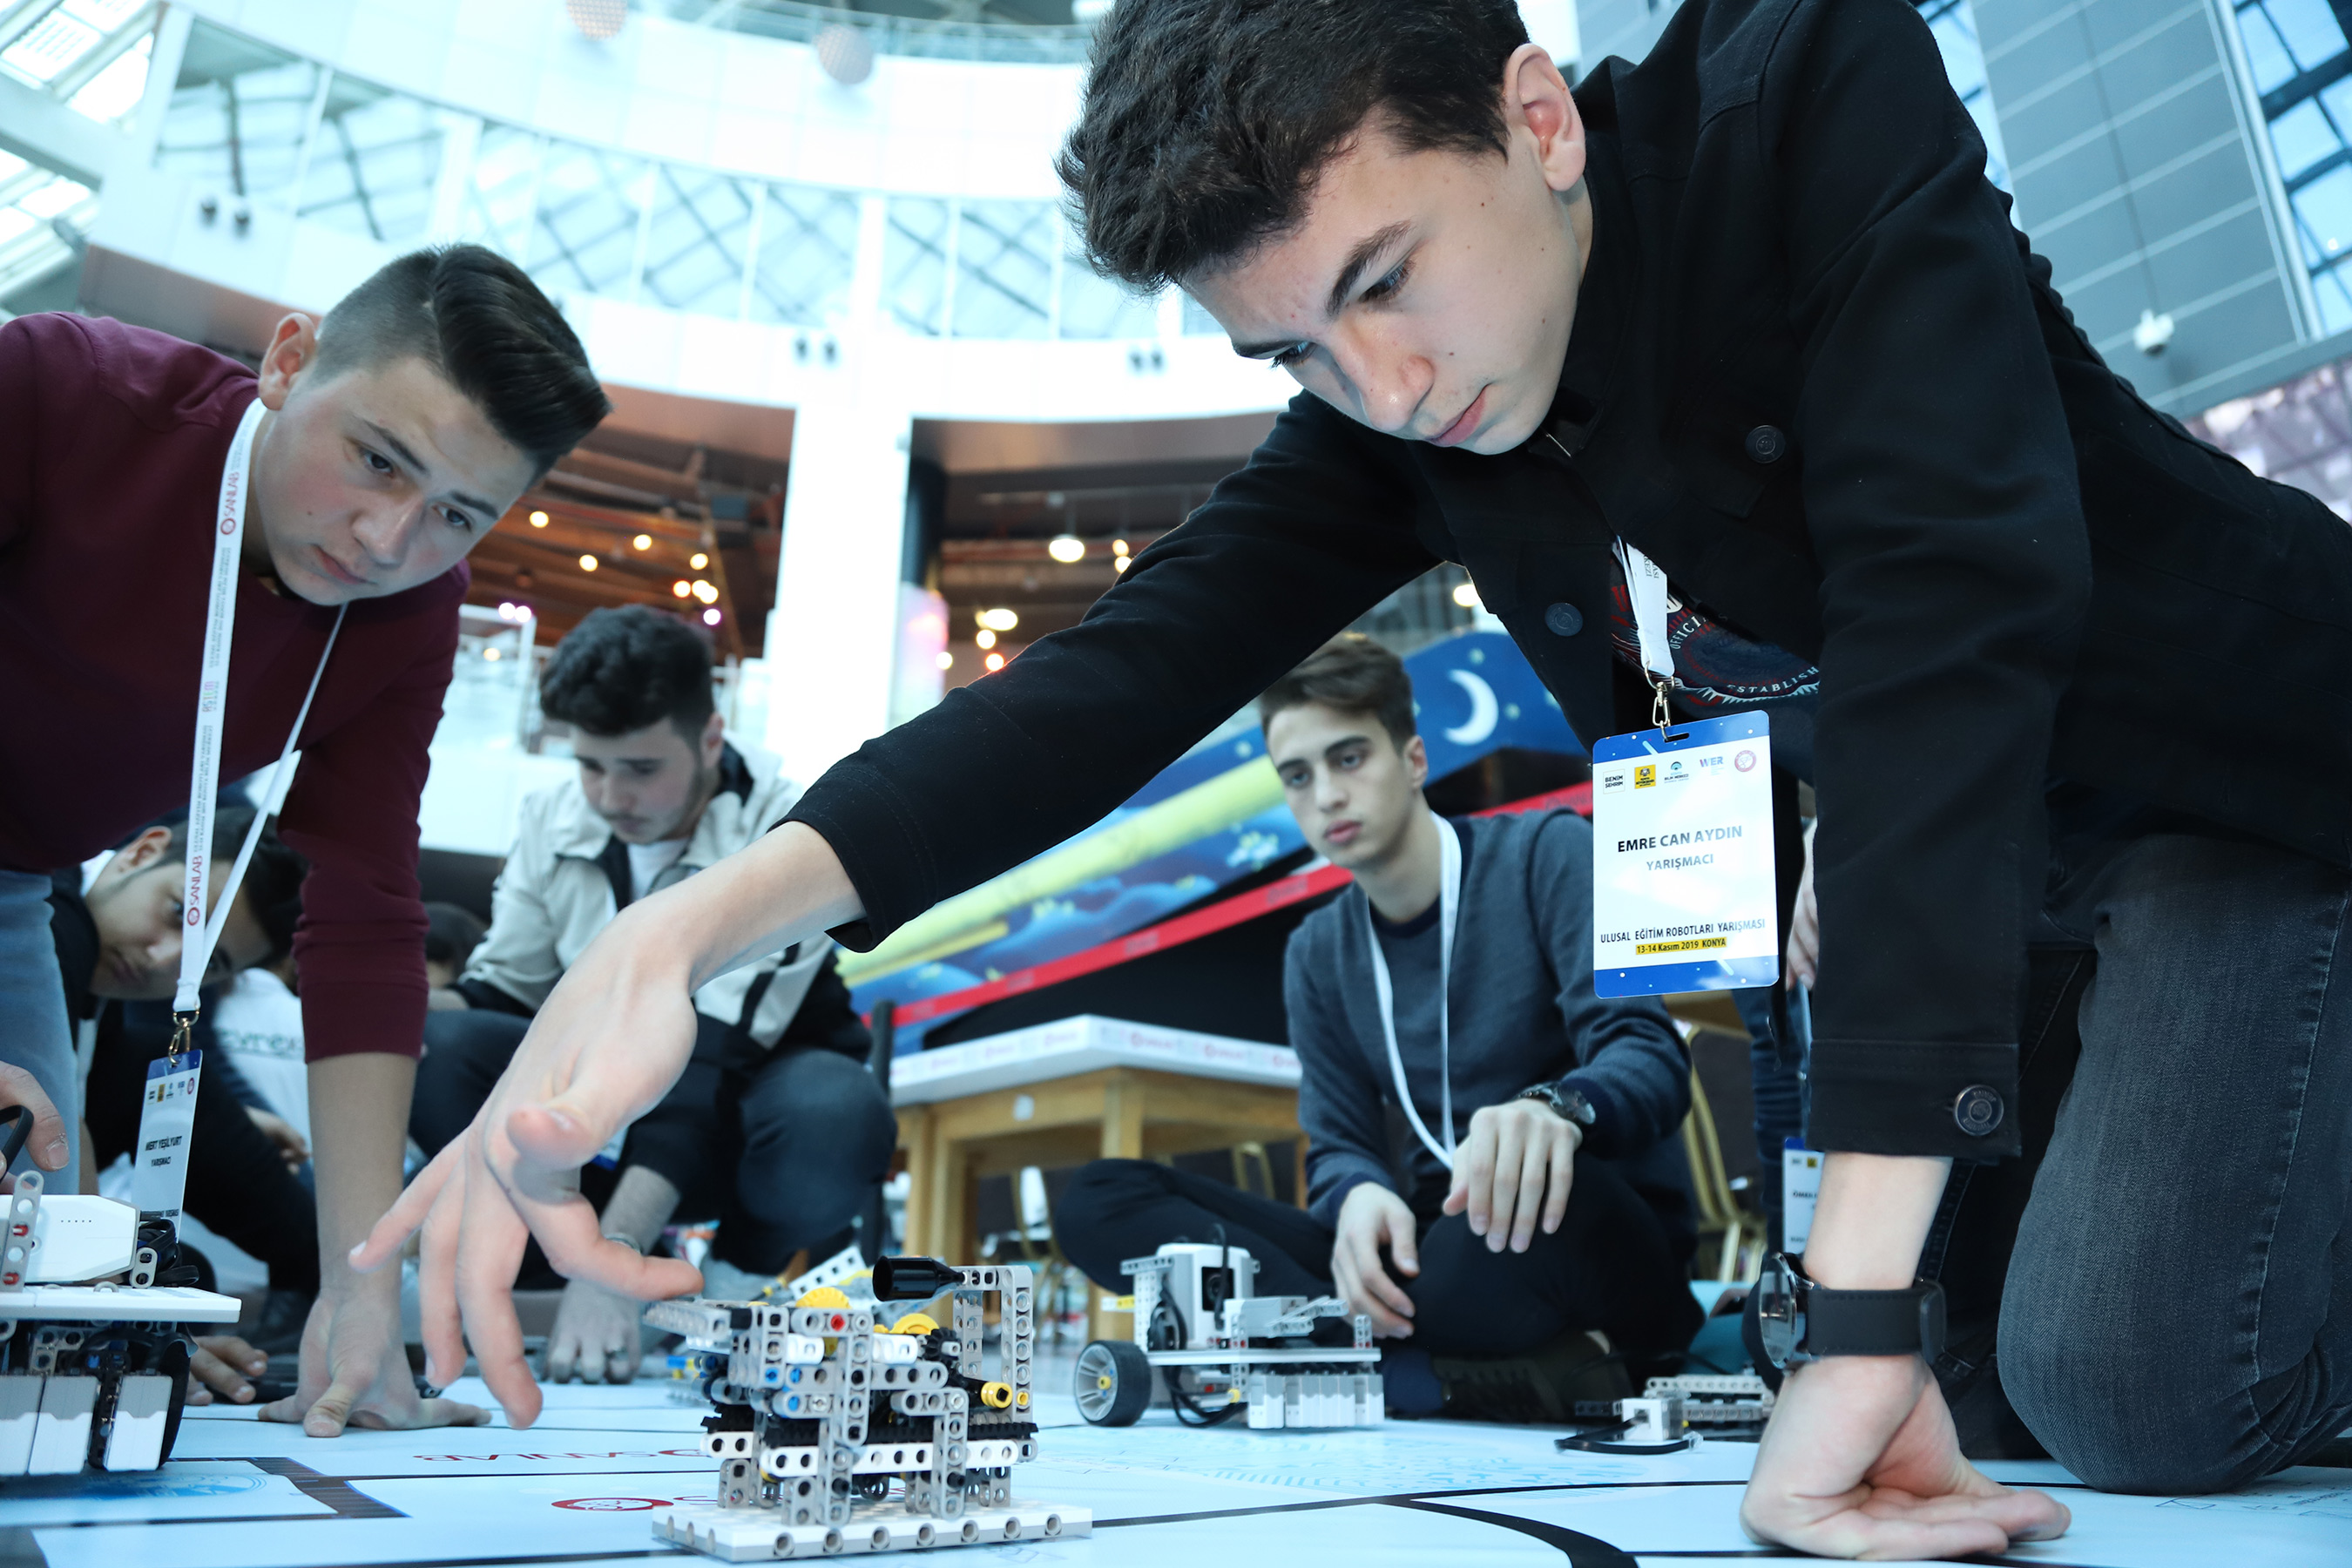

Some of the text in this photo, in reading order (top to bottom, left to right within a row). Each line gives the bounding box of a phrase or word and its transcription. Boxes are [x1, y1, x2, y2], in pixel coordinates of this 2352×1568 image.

[224, 471, 240, 517] SANLAB
[1670, 616, 1707, 650] OFFICI
[1618, 825, 1742, 853] EMRE CAN AYDIN
[1646, 854, 1713, 871] YARIŞMACI
[190, 855, 202, 906] SANLAB
[1601, 918, 1766, 943] ULUSAL EĞİTİM ROBOTLARI YARIŞMASI
[1637, 938, 1726, 954] 13-14 Kasım 2019 KONYA
